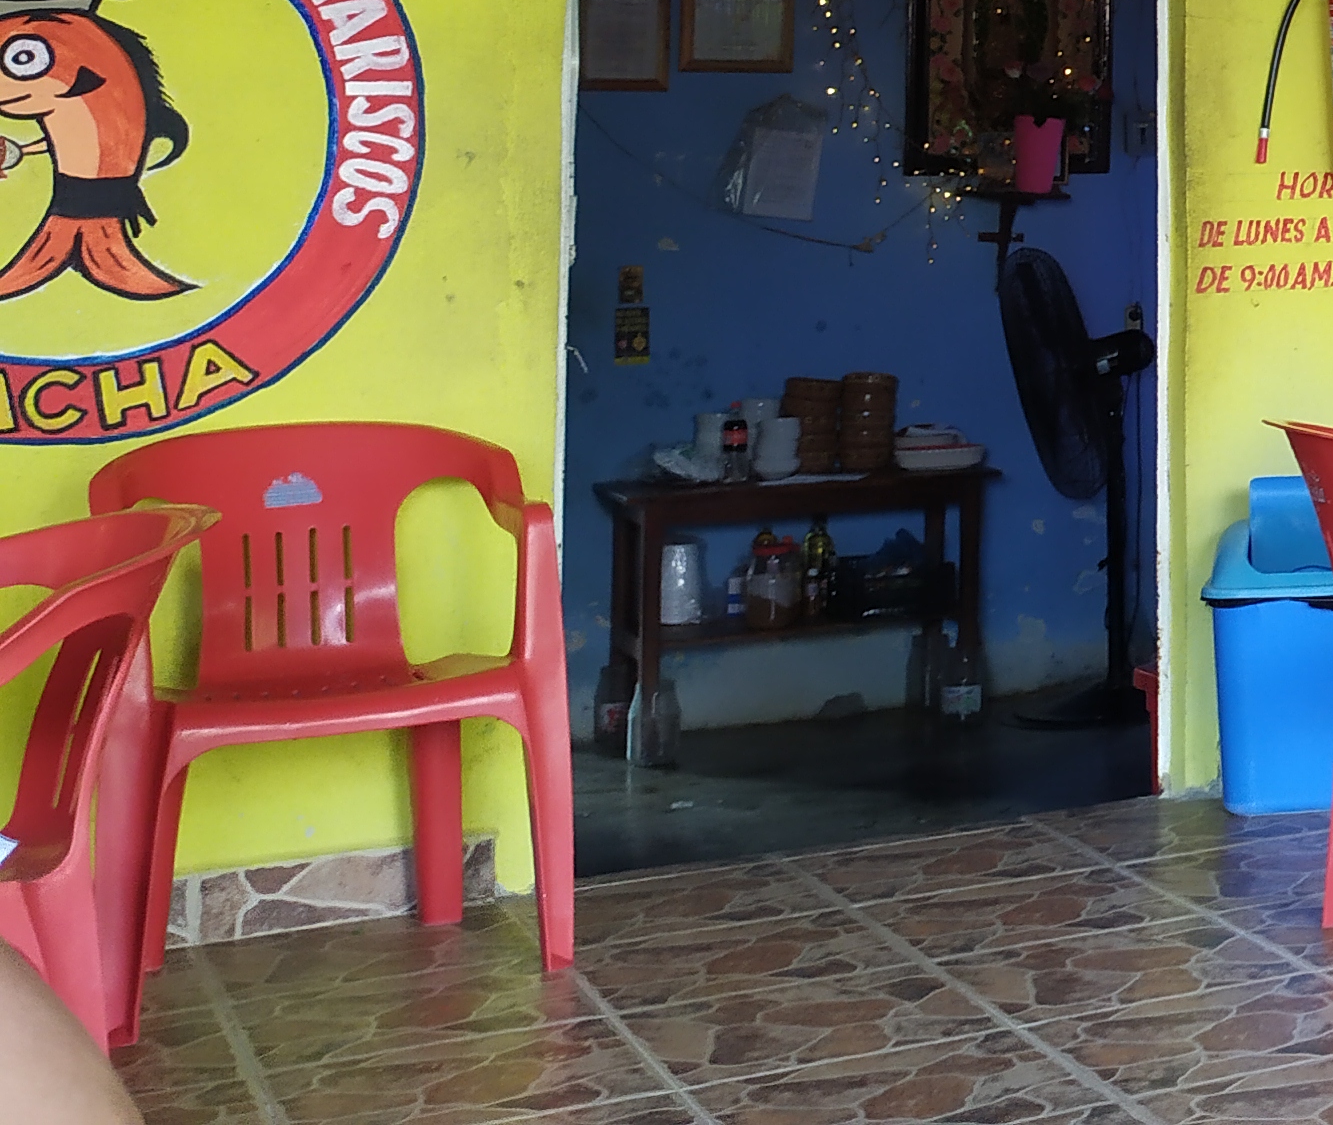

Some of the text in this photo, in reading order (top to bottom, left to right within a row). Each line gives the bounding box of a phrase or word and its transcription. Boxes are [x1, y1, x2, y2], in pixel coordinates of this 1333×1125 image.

[1198, 220, 1225, 248] DE
[1233, 217, 1306, 247] LUNES
[1314, 216, 1332, 244] A
[1195, 265, 1232, 295] DE
